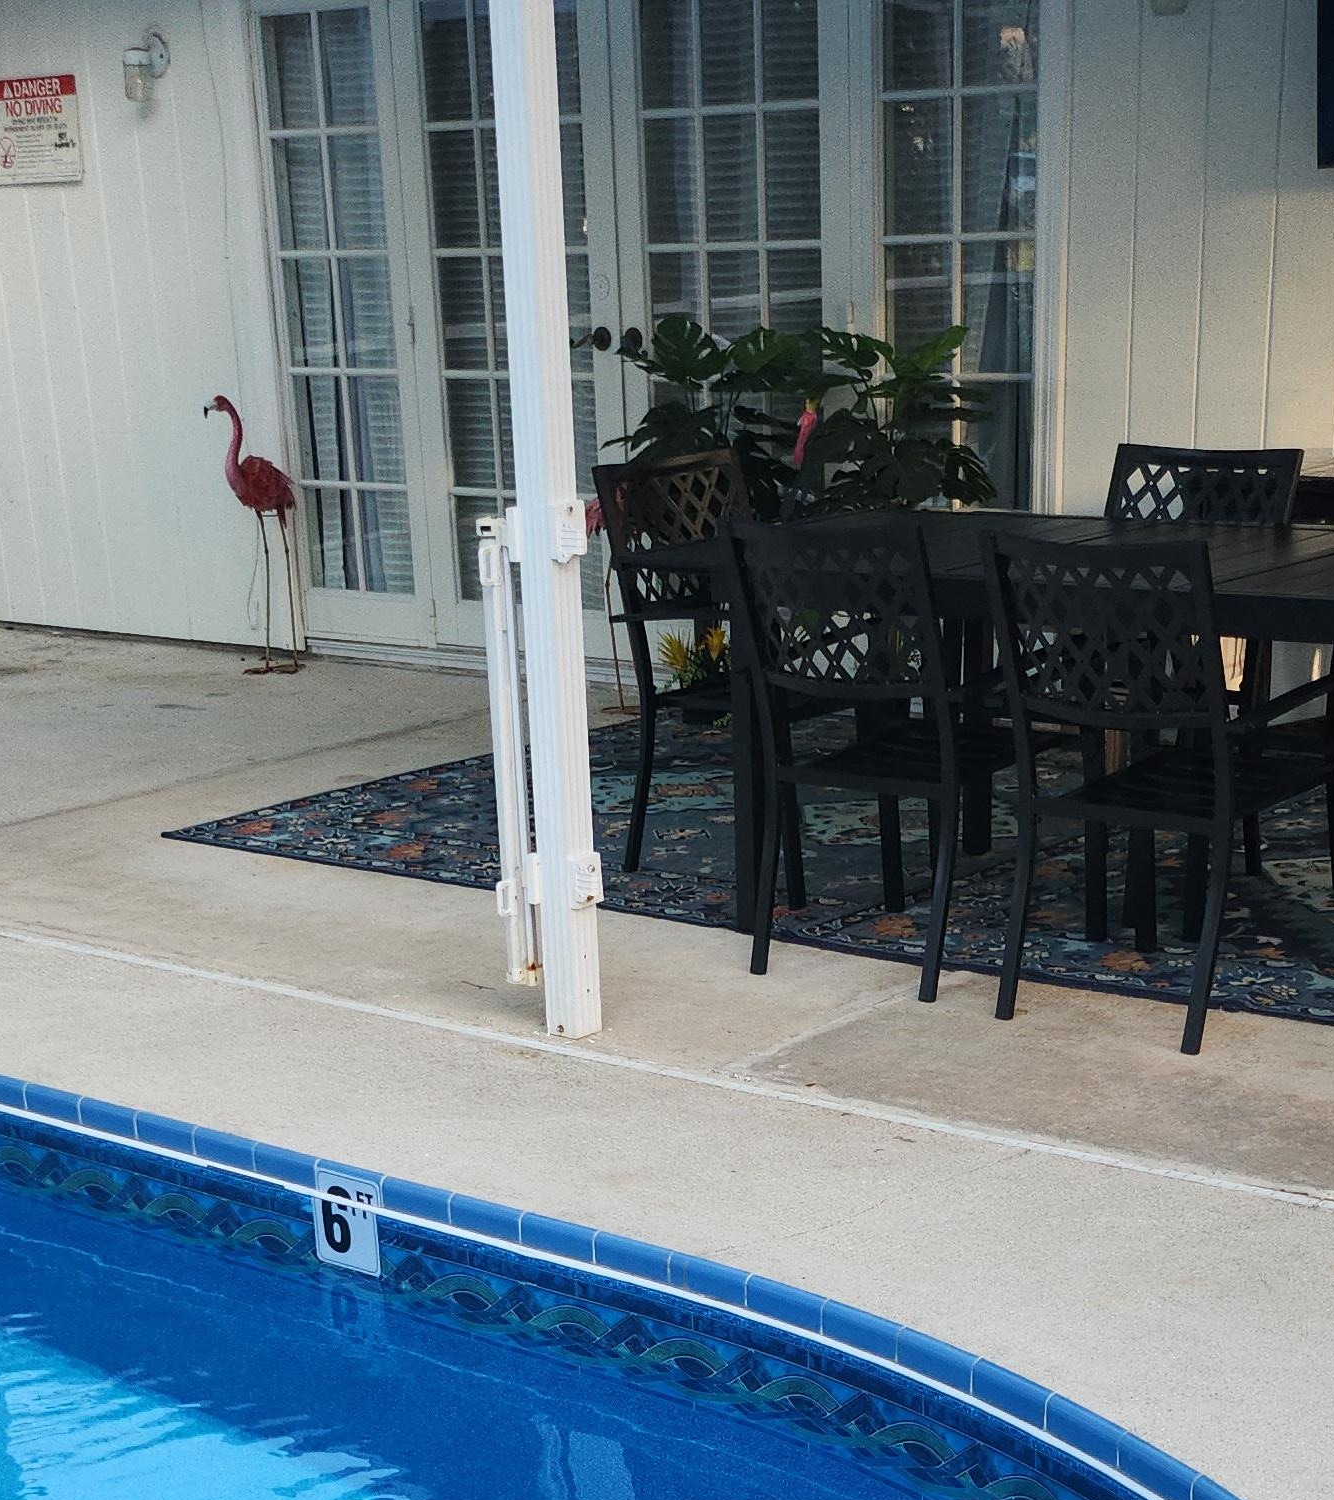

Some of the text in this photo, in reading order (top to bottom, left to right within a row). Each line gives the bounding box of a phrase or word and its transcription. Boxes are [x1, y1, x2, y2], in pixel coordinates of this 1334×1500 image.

[12, 78, 62, 98] DANGER
[5, 98, 63, 117] NO DIVING
[321, 1185, 374, 1254] 6 FT
